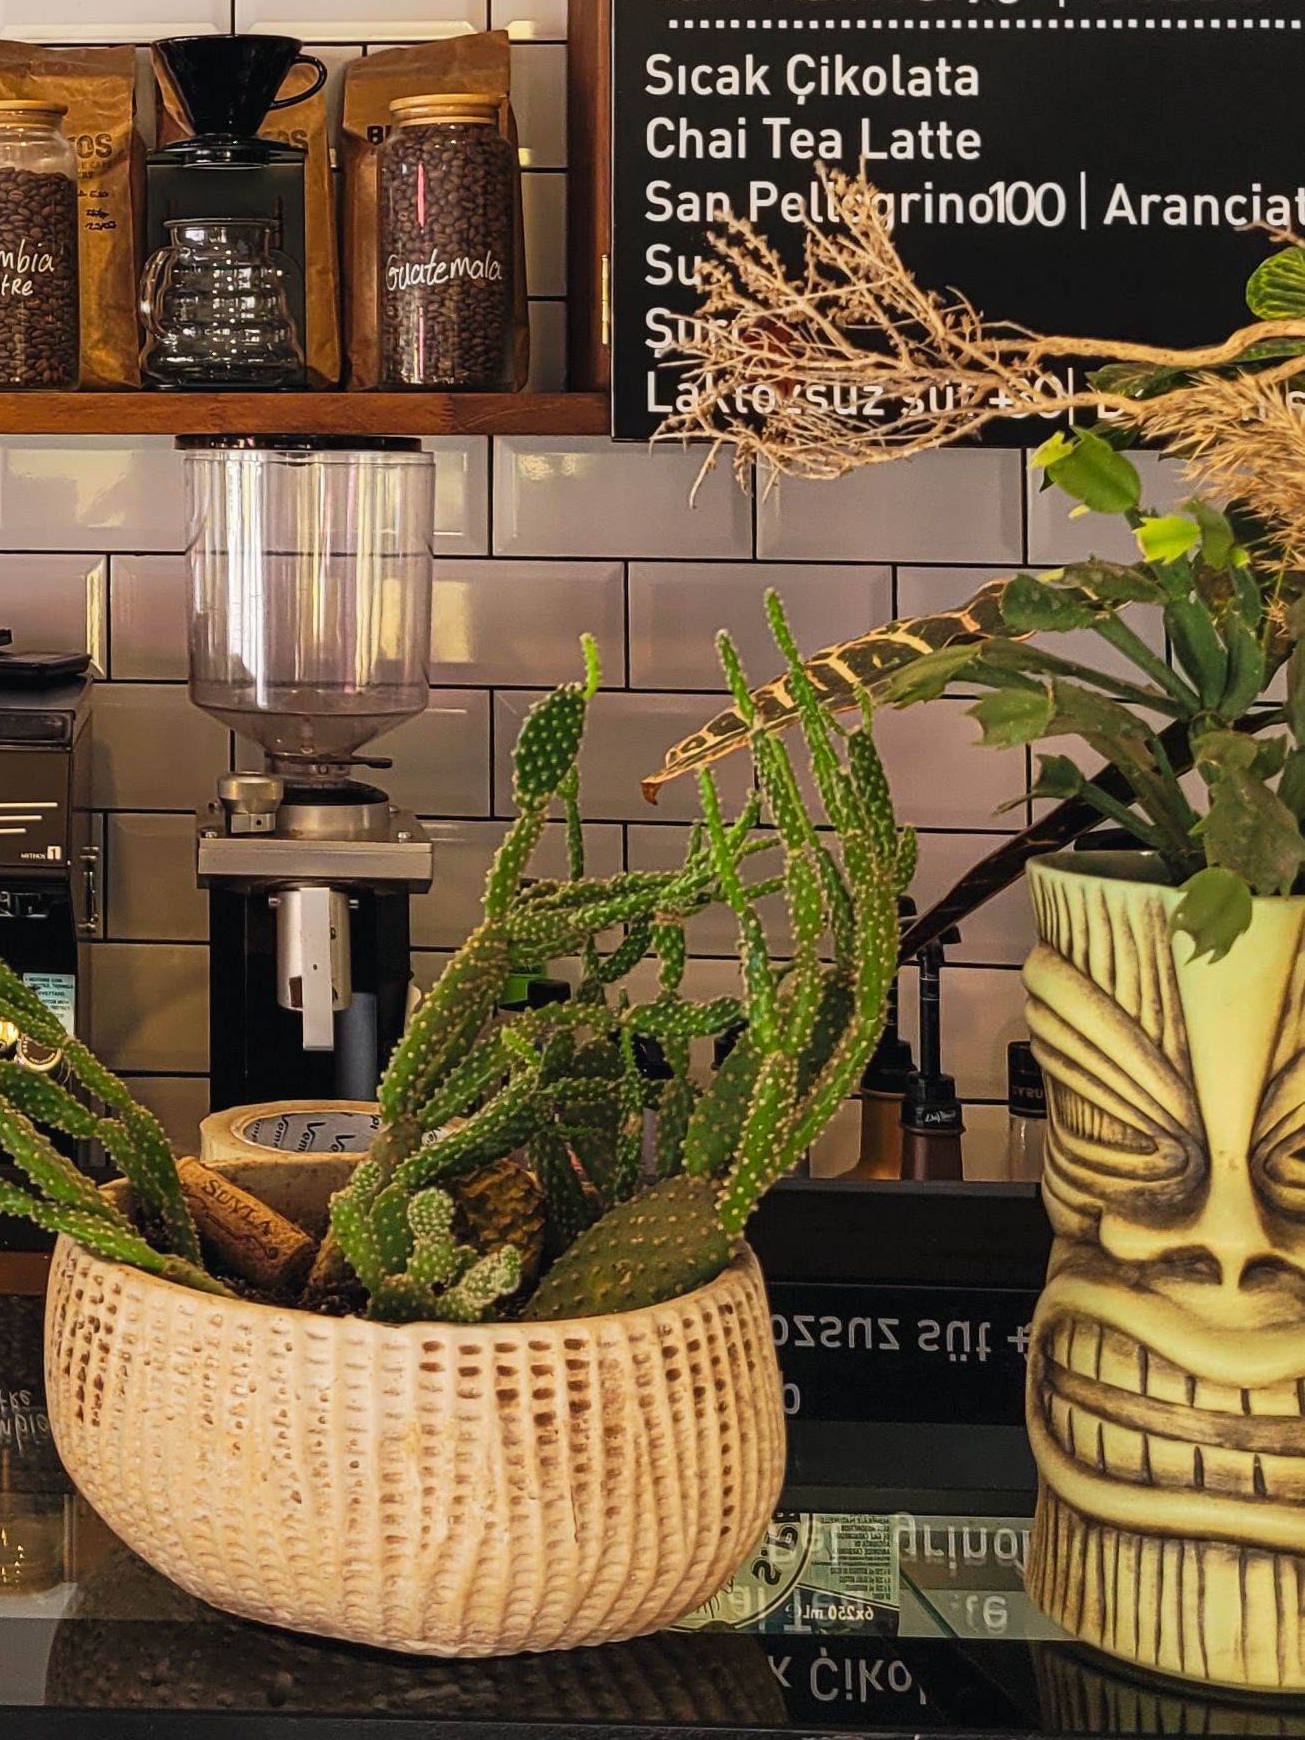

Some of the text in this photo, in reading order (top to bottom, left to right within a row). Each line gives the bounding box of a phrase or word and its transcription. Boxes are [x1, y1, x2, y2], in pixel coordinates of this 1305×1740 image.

[645, 53, 979, 105] Sıcak Çikolata
[646, 116, 981, 160] Chai Tea Latte
[645, 180, 730, 223] San
[749, 180, 993, 232] Pellgrino
[986, 180, 1066, 227] 100
[386, 248, 503, 291] Guatemala
